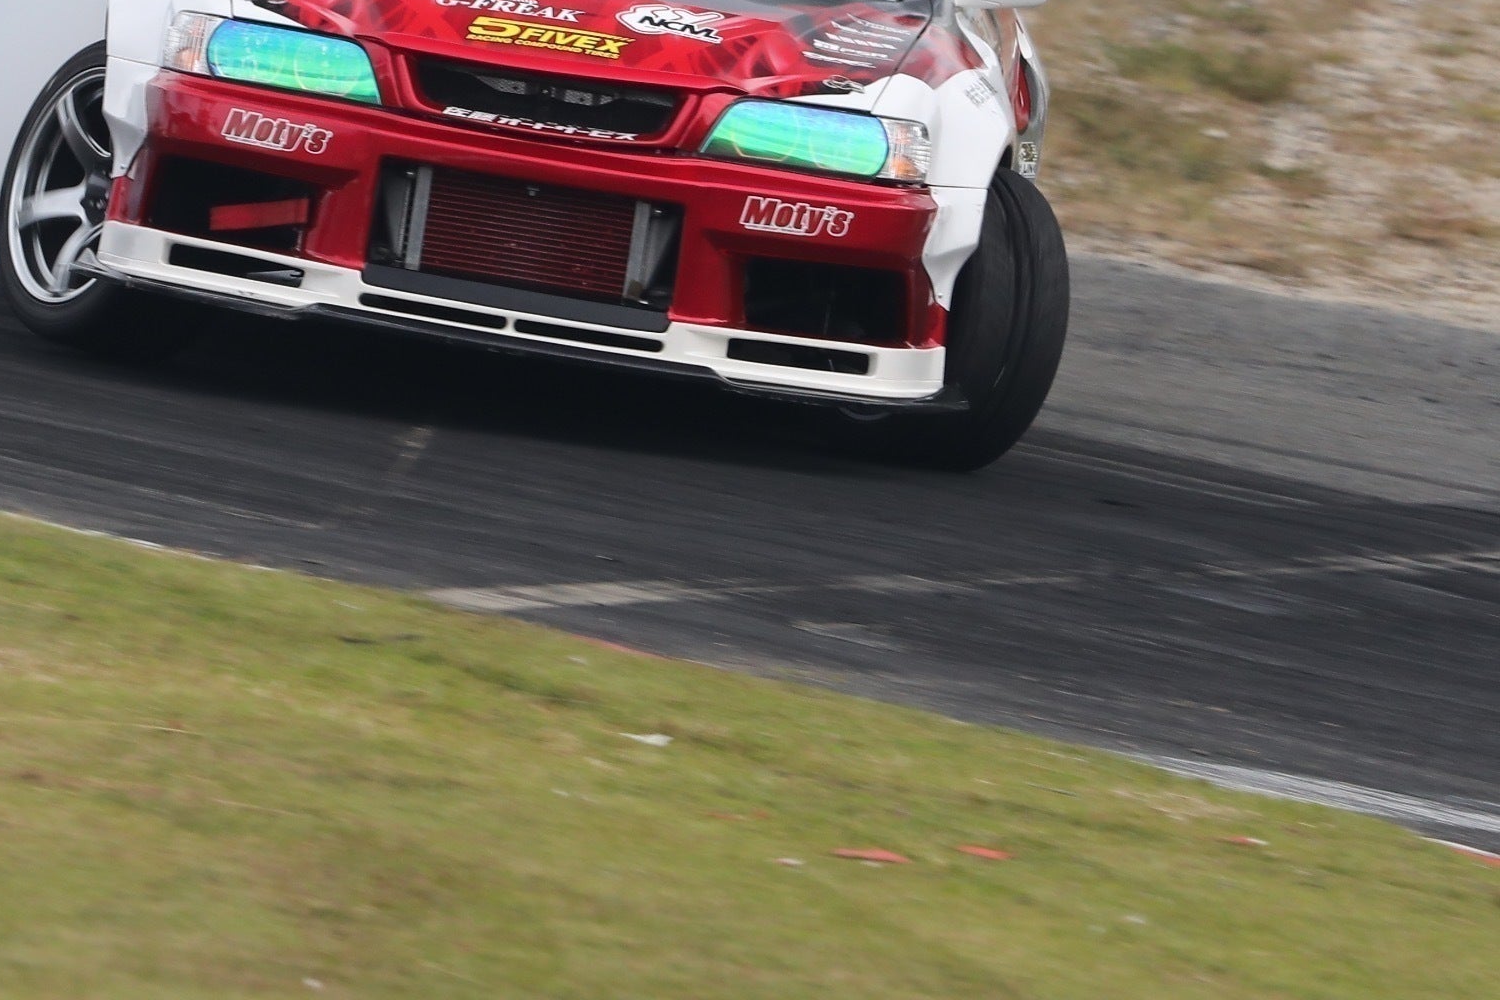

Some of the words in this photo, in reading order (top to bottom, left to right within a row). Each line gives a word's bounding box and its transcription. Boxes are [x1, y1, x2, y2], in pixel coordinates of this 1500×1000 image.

[465, 34, 513, 45] RACING
[514, 39, 583, 53] COMPOUND
[584, 48, 621, 60] TIRES
[221, 108, 334, 154] Moty's
[739, 195, 855, 237] Moty's
